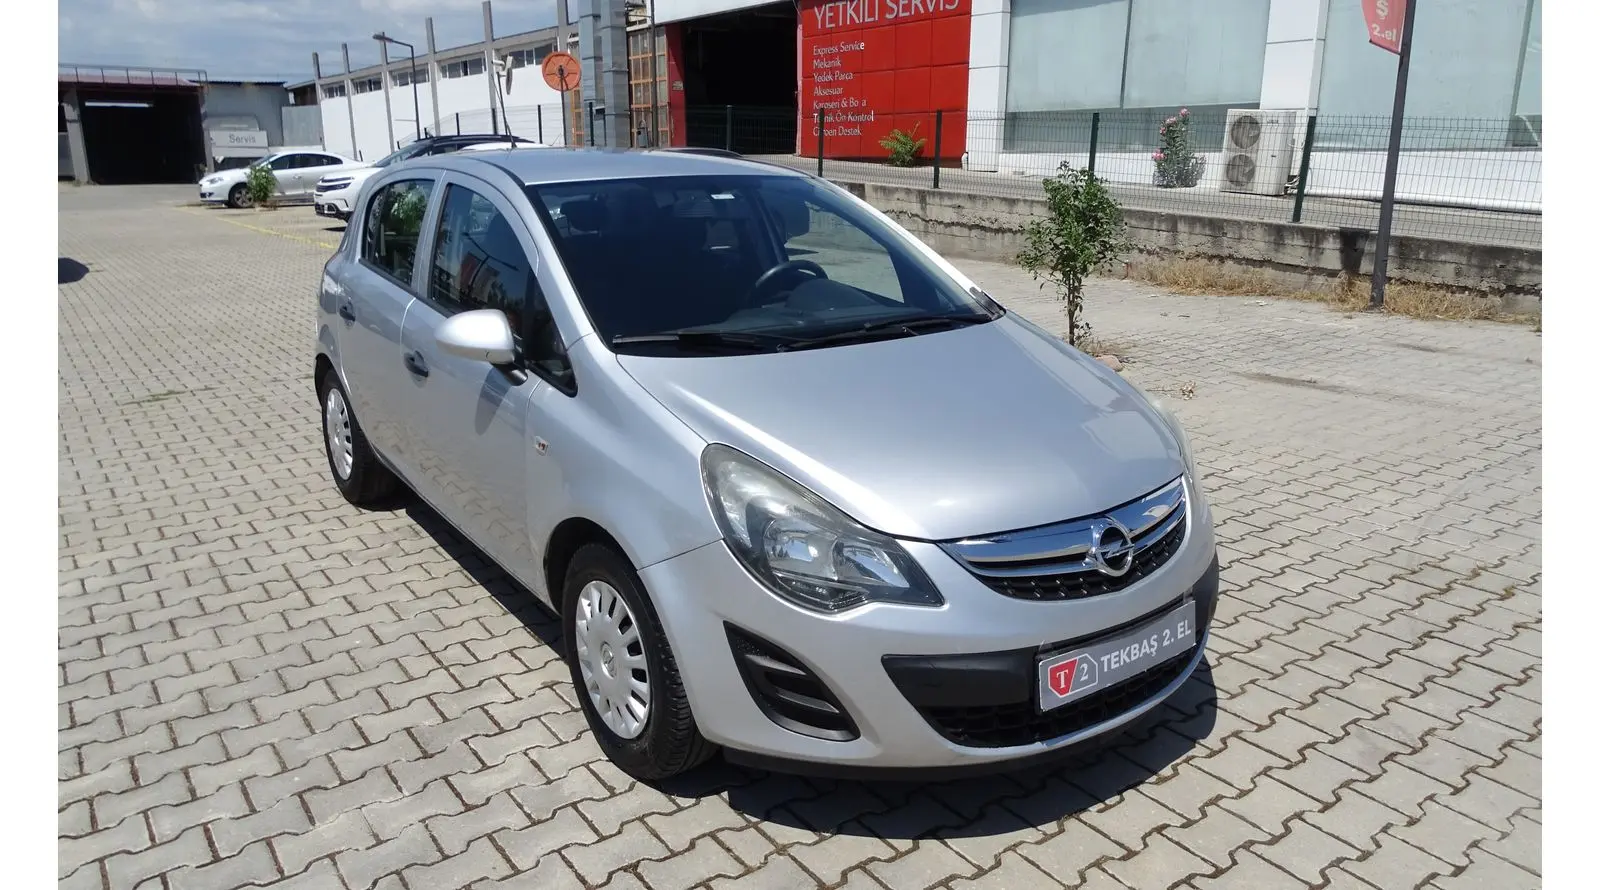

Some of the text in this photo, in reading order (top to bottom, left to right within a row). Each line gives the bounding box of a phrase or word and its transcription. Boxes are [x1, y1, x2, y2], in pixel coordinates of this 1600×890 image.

[1371, 23, 1397, 41] 2.el
[813, 41, 865, 57] Express Service
[813, 56, 841, 69] Mekanik
[813, 71, 833, 82] Yedek
[813, 86, 843, 96] Aksesuar
[841, 97, 848, 108] &
[813, 112, 834, 123] Tnik
[847, 110, 874, 121] Kontrol
[813, 124, 862, 136] Cioen Destek
[229, 133, 256, 144] Servis
[1056, 619, 1191, 689] T 2 TEKBAŞ 2. EL
